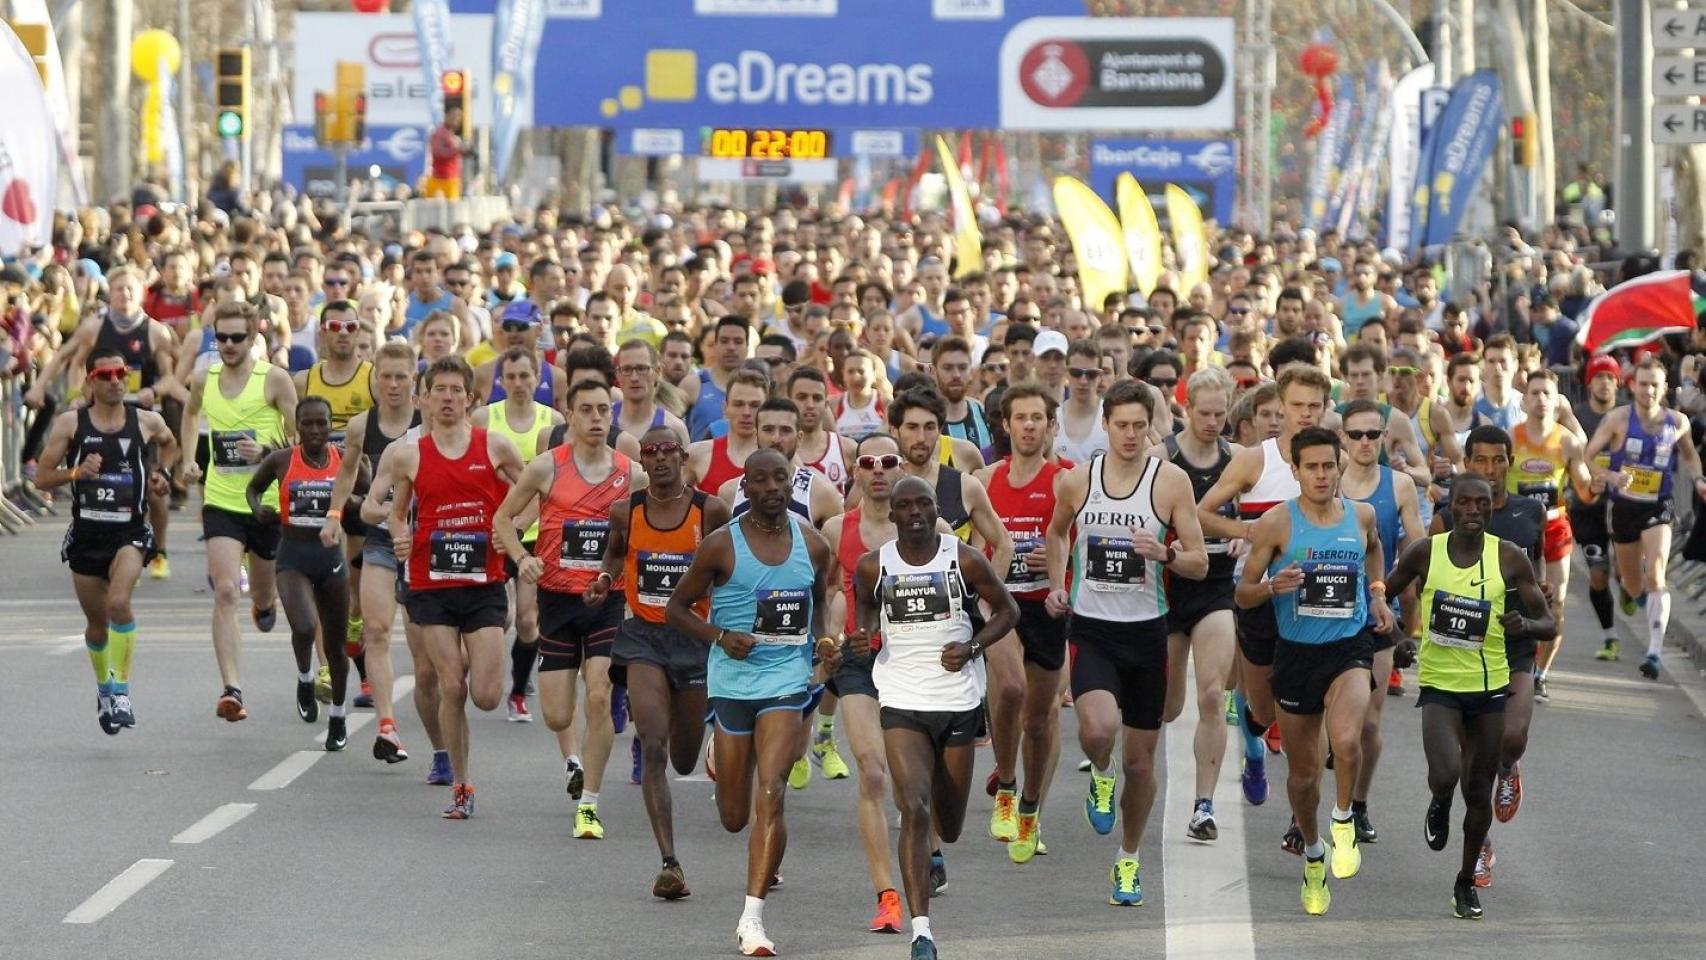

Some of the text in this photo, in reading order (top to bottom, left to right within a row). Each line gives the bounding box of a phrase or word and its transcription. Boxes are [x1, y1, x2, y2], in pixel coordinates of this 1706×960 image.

[1101, 51, 1182, 70] Ajuntament
[706, 49, 934, 105] eDreams
[1101, 68, 1205, 91] Barcelona
[1446, 84, 1492, 172] eDreams
[711, 129, 747, 159] 00
[97, 487, 115, 501] 92
[311, 498, 319, 510] 1
[1084, 511, 1150, 528] DERBY
[579, 530, 605, 538] KEMPF
[445, 541, 475, 552] FLÜGEL
[582, 539, 599, 552] 49
[450, 552, 467, 565] 14
[1104, 550, 1128, 560] WEIR
[1312, 549, 1360, 561] ESERCITO
[646, 563, 689, 573] MOHAMED
[1011, 562, 1028, 574] 20
[1106, 560, 1123, 573] 51
[660, 574, 671, 588] 4
[1316, 575, 1348, 584] MEUCCI
[896, 586, 937, 598] MANYUR
[1325, 585, 1335, 598] 3
[776, 602, 800, 611] SANG
[906, 597, 926, 612] 58
[781, 613, 791, 626] 8
[1449, 616, 1467, 630] 10
